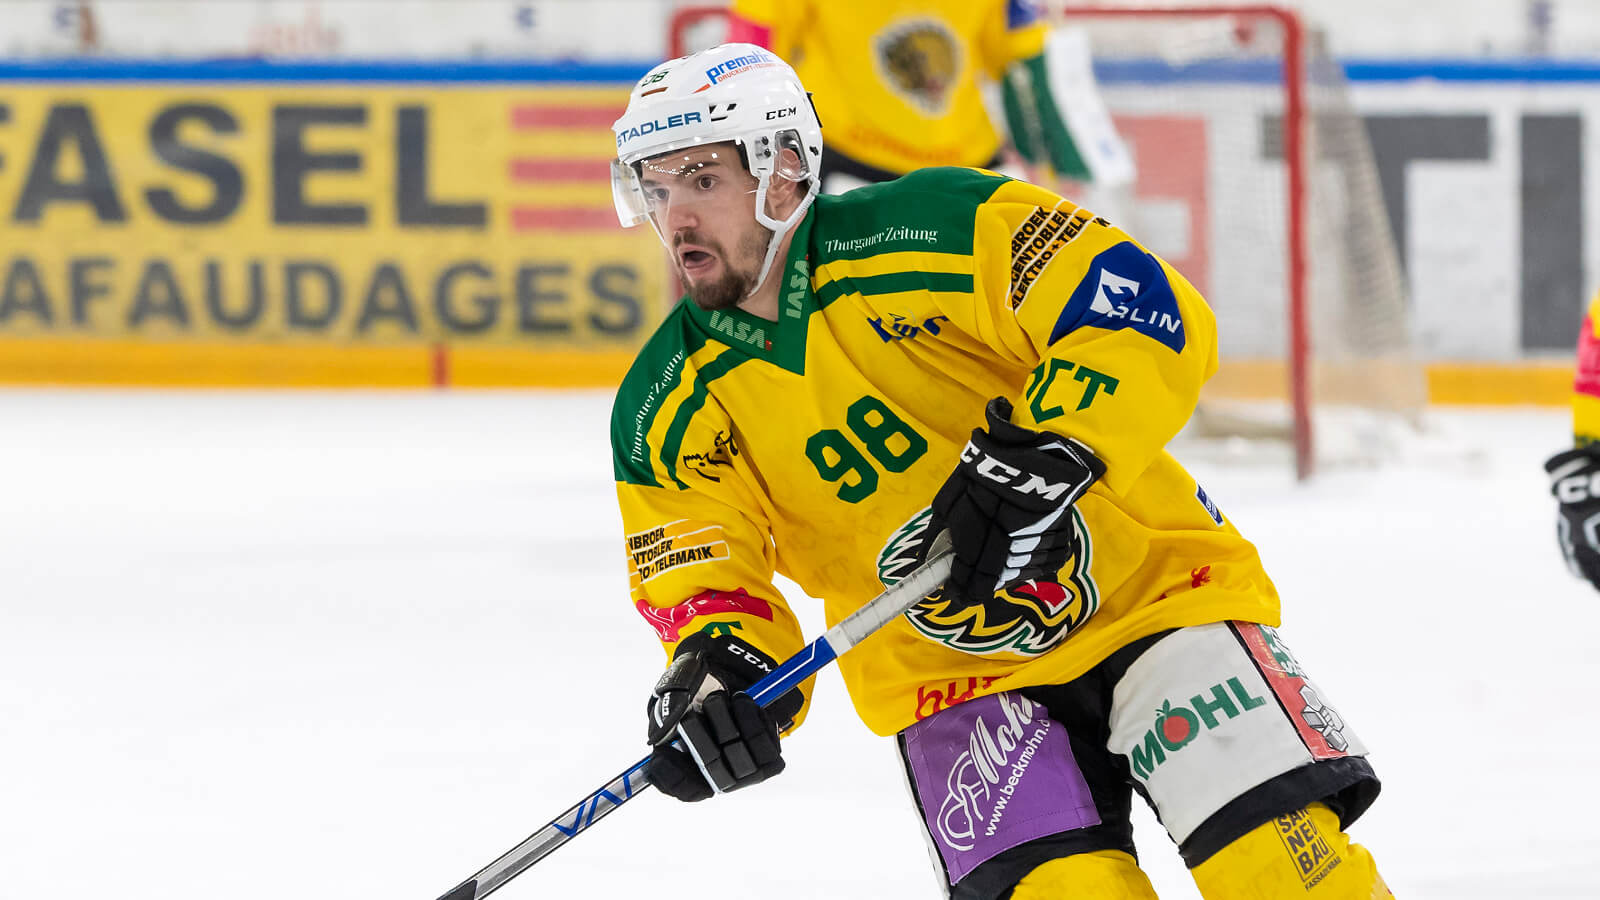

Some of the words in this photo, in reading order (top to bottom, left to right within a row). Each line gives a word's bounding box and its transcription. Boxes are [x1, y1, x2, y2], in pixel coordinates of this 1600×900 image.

[617, 111, 702, 148] STADLER
[766, 106, 797, 120] CCM
[0, 103, 488, 226] ASEL
[885, 225, 939, 245] Zeitung
[1011, 210, 1070, 292] GENTOBLE
[1012, 206, 1050, 259] BROEK
[805, 395, 928, 504] 98
[960, 439, 1071, 501] CCM
[1297, 836, 1330, 875] BAU
